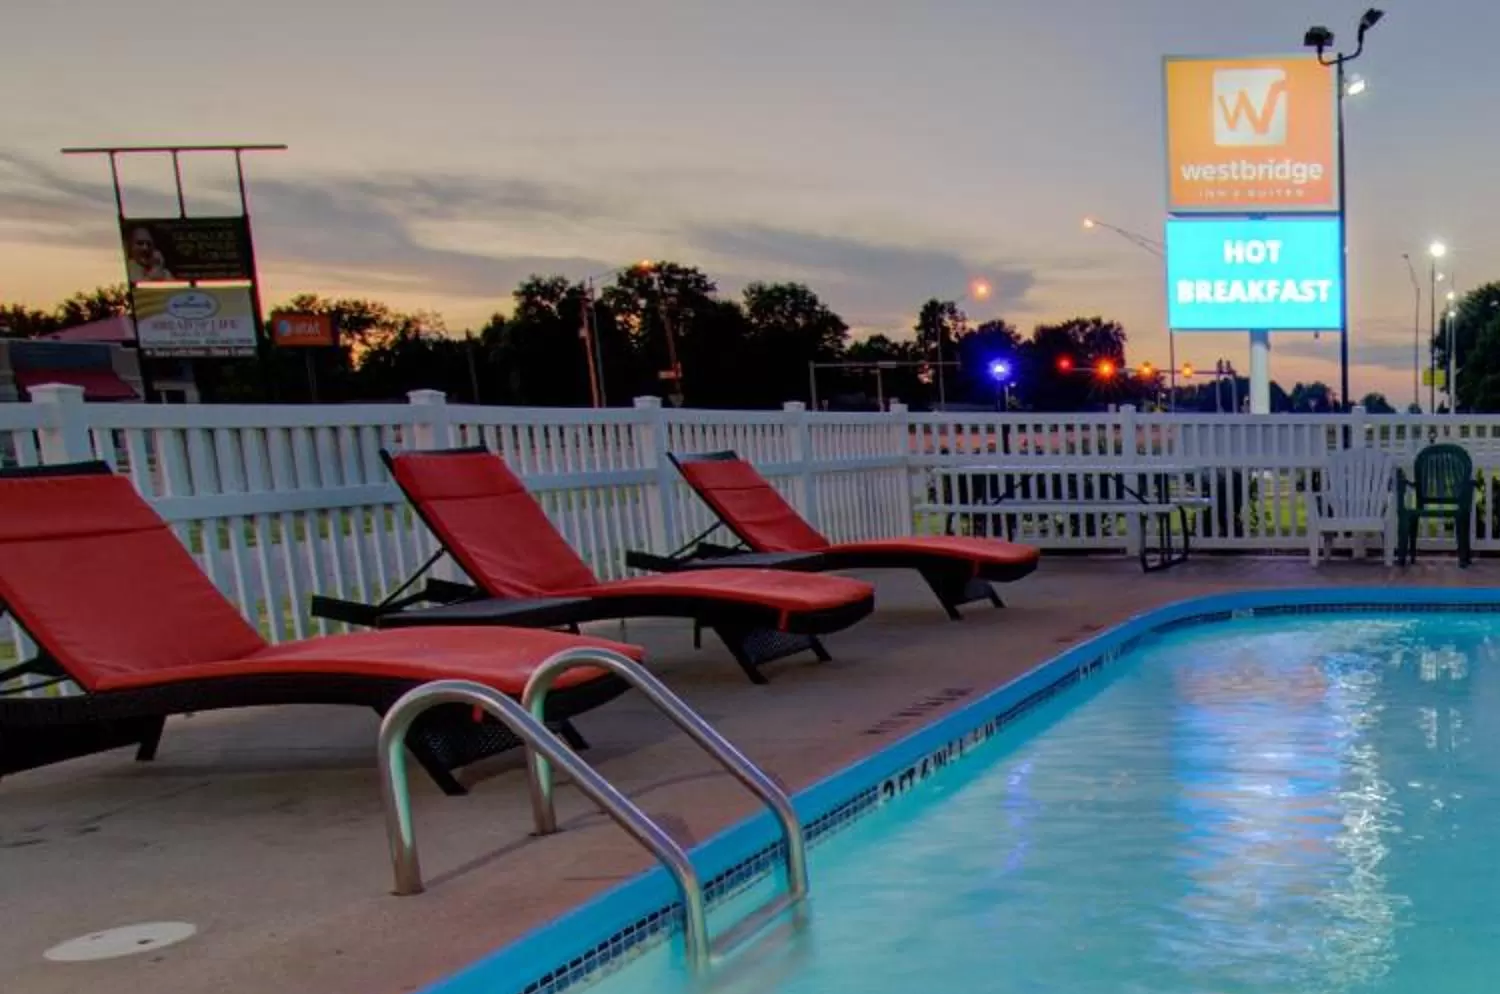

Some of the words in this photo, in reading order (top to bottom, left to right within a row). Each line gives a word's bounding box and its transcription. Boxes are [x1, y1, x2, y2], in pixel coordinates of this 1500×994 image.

[1180, 159, 1323, 184] westbridge
[1223, 239, 1282, 263] HOT
[1176, 279, 1333, 304] BREAKFAST
